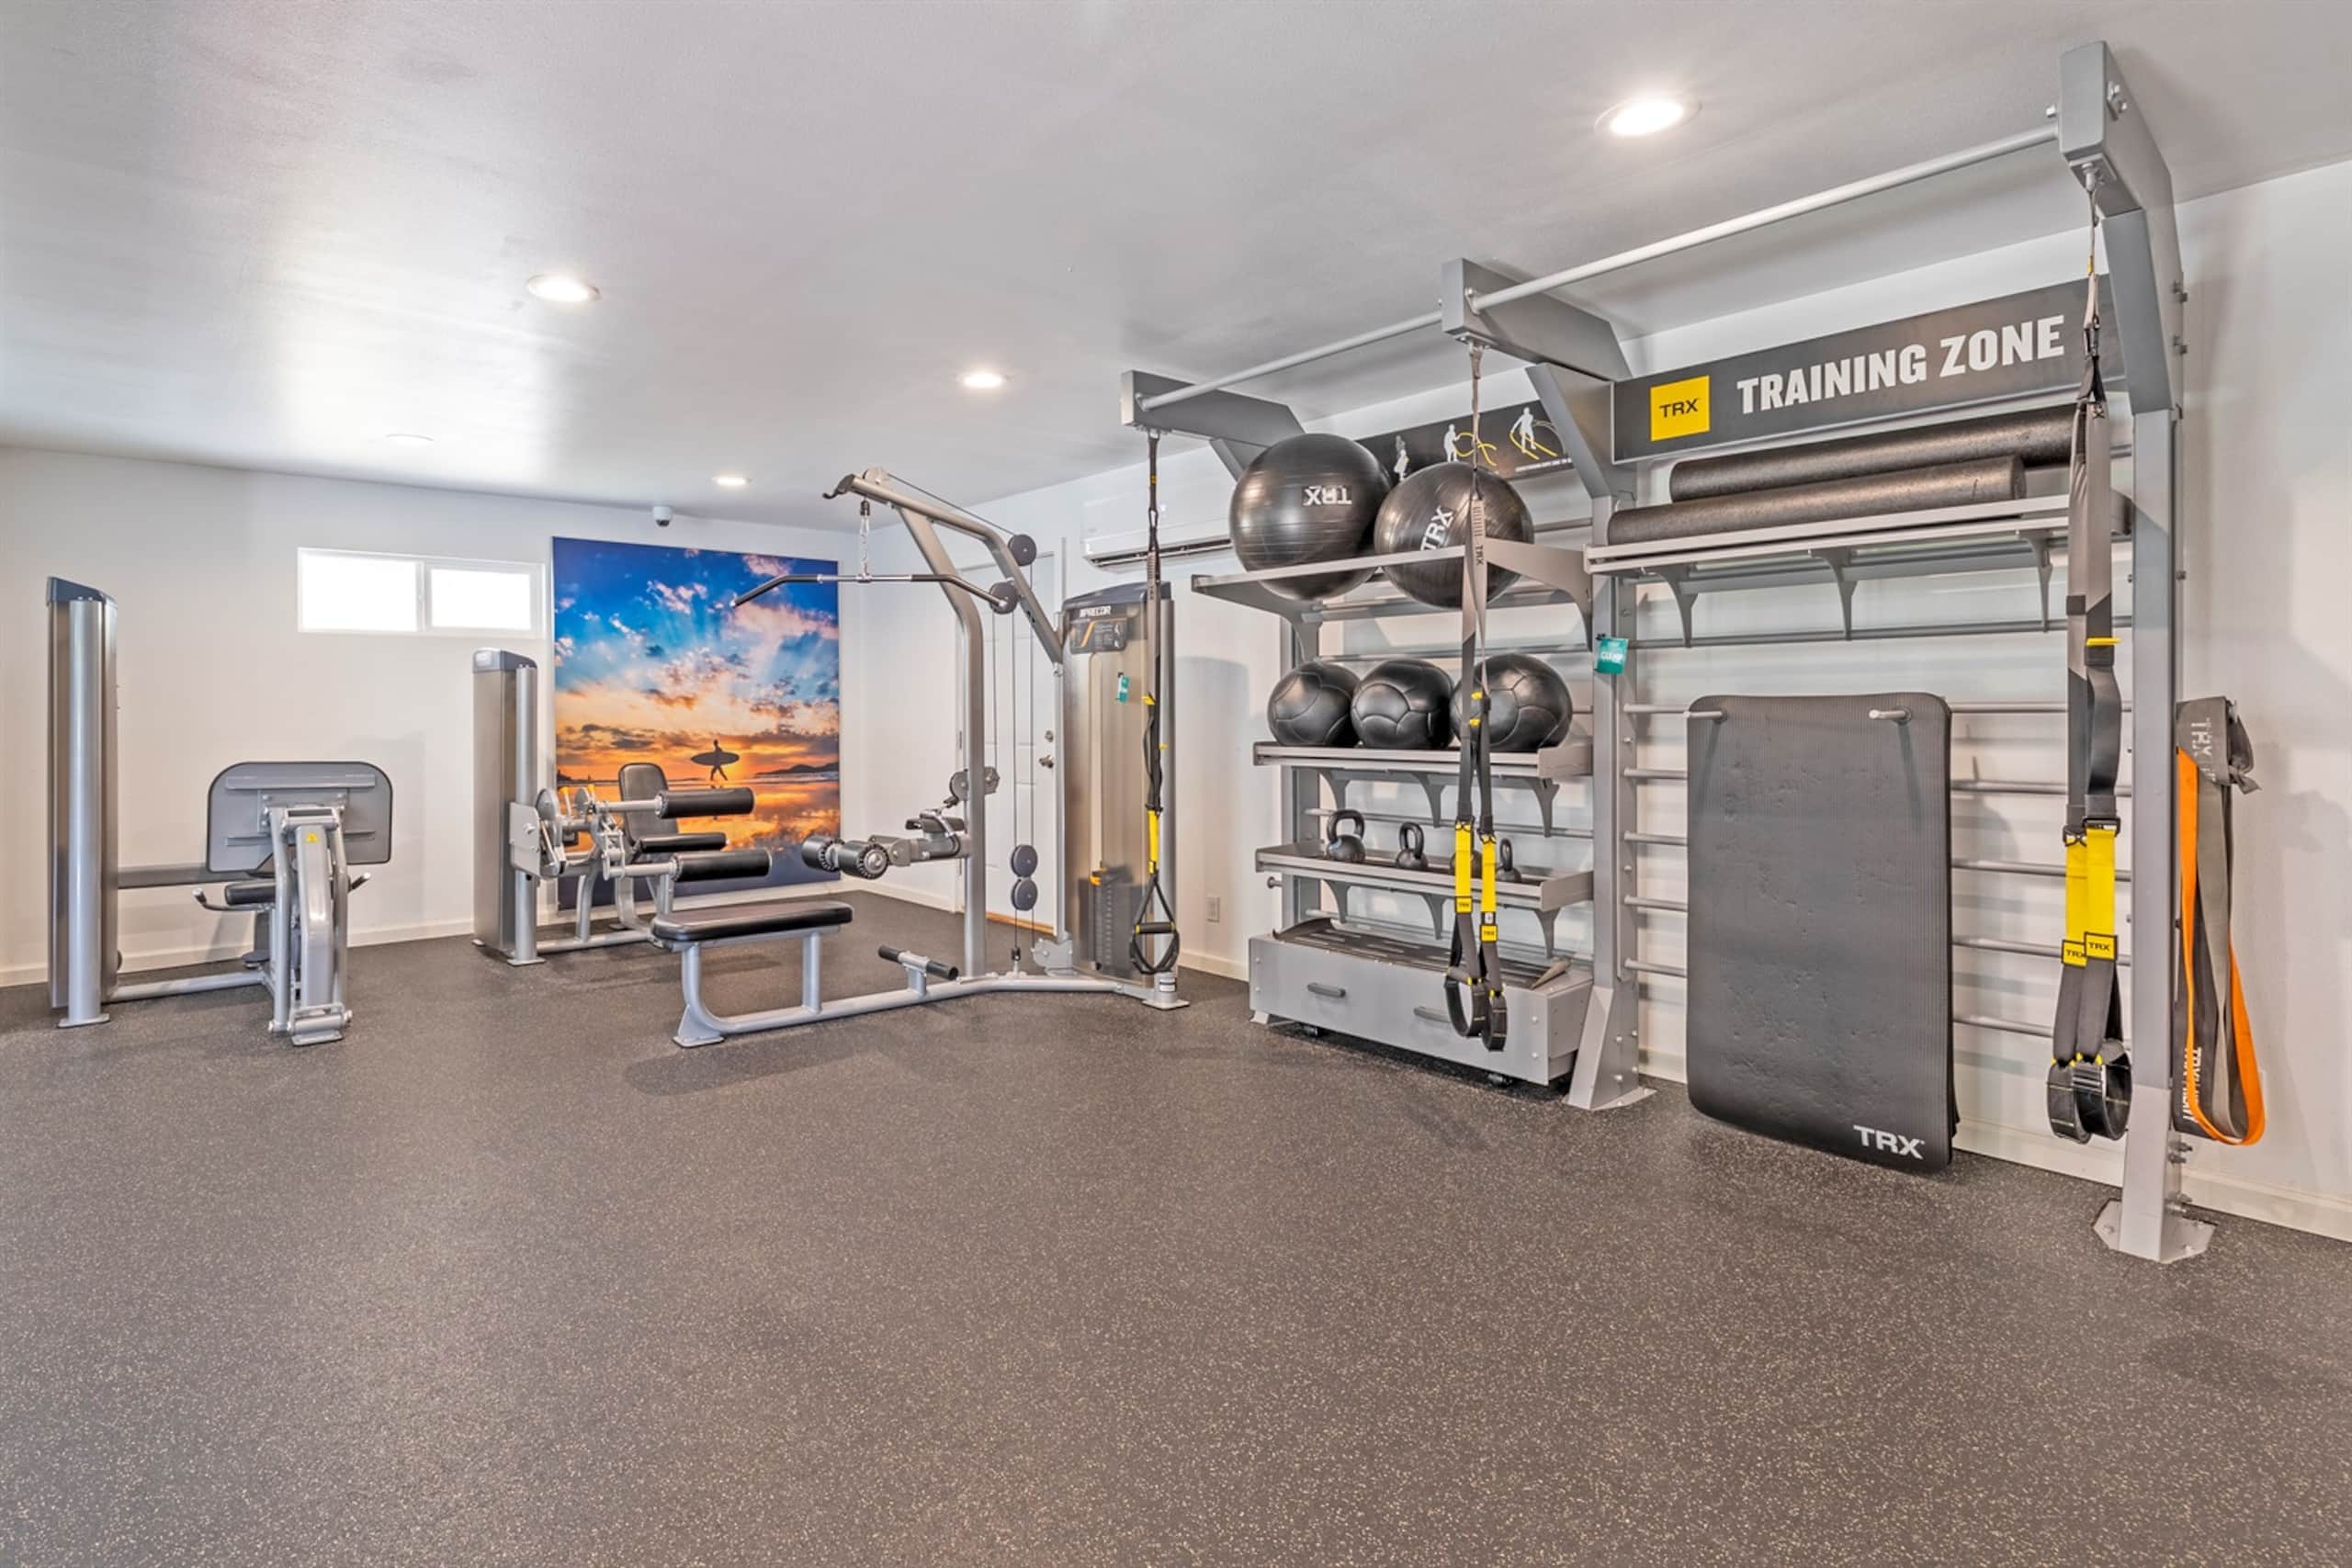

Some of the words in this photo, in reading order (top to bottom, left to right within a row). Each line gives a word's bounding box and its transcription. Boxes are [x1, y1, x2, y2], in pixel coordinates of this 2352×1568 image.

[1736, 344, 1927, 414] TRAINING
[1939, 314, 2065, 378] ZONE
[1658, 398, 1699, 418] TRX
[1303, 485, 1352, 506] TRX
[1420, 505, 1453, 551] TRX
[2087, 941, 2111, 952] TRX
[1853, 1124, 1924, 1160] TRX
